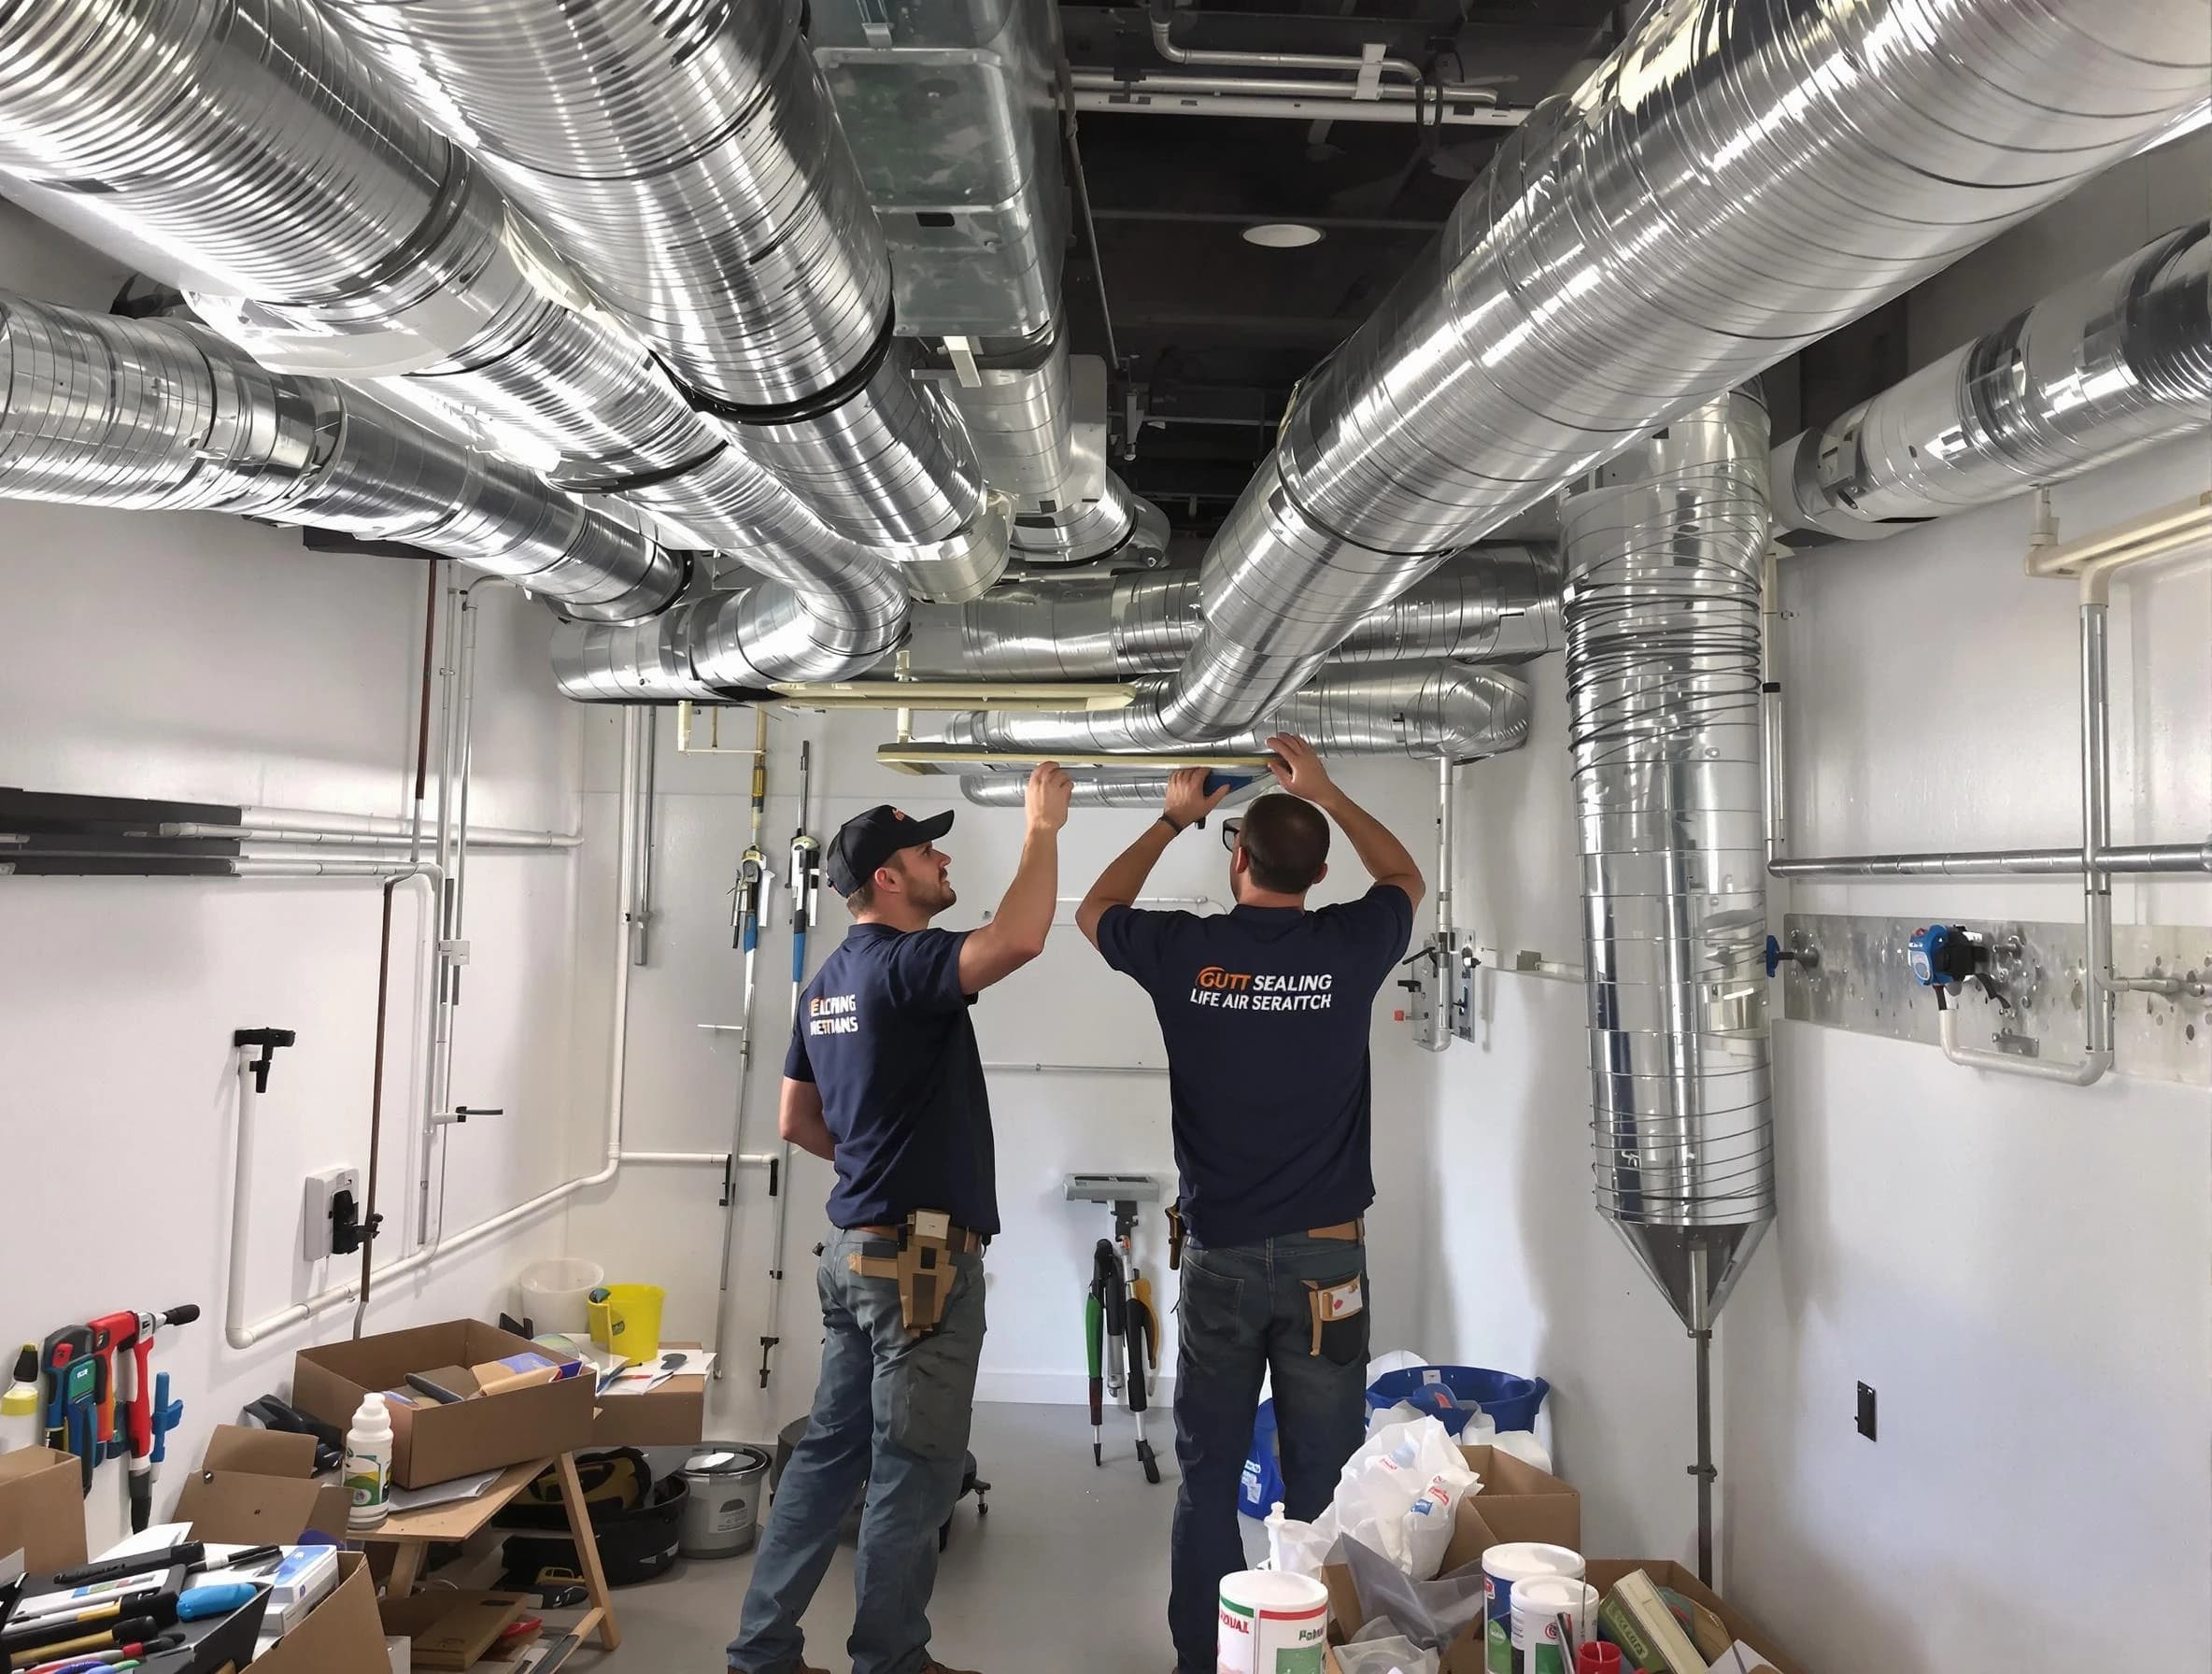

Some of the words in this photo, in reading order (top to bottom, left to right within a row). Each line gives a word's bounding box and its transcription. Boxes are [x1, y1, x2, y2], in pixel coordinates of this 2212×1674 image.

[1253, 973, 1332, 992] SEALING
[1190, 988, 1221, 1007] LIFE
[1222, 993, 1249, 1010] AIR
